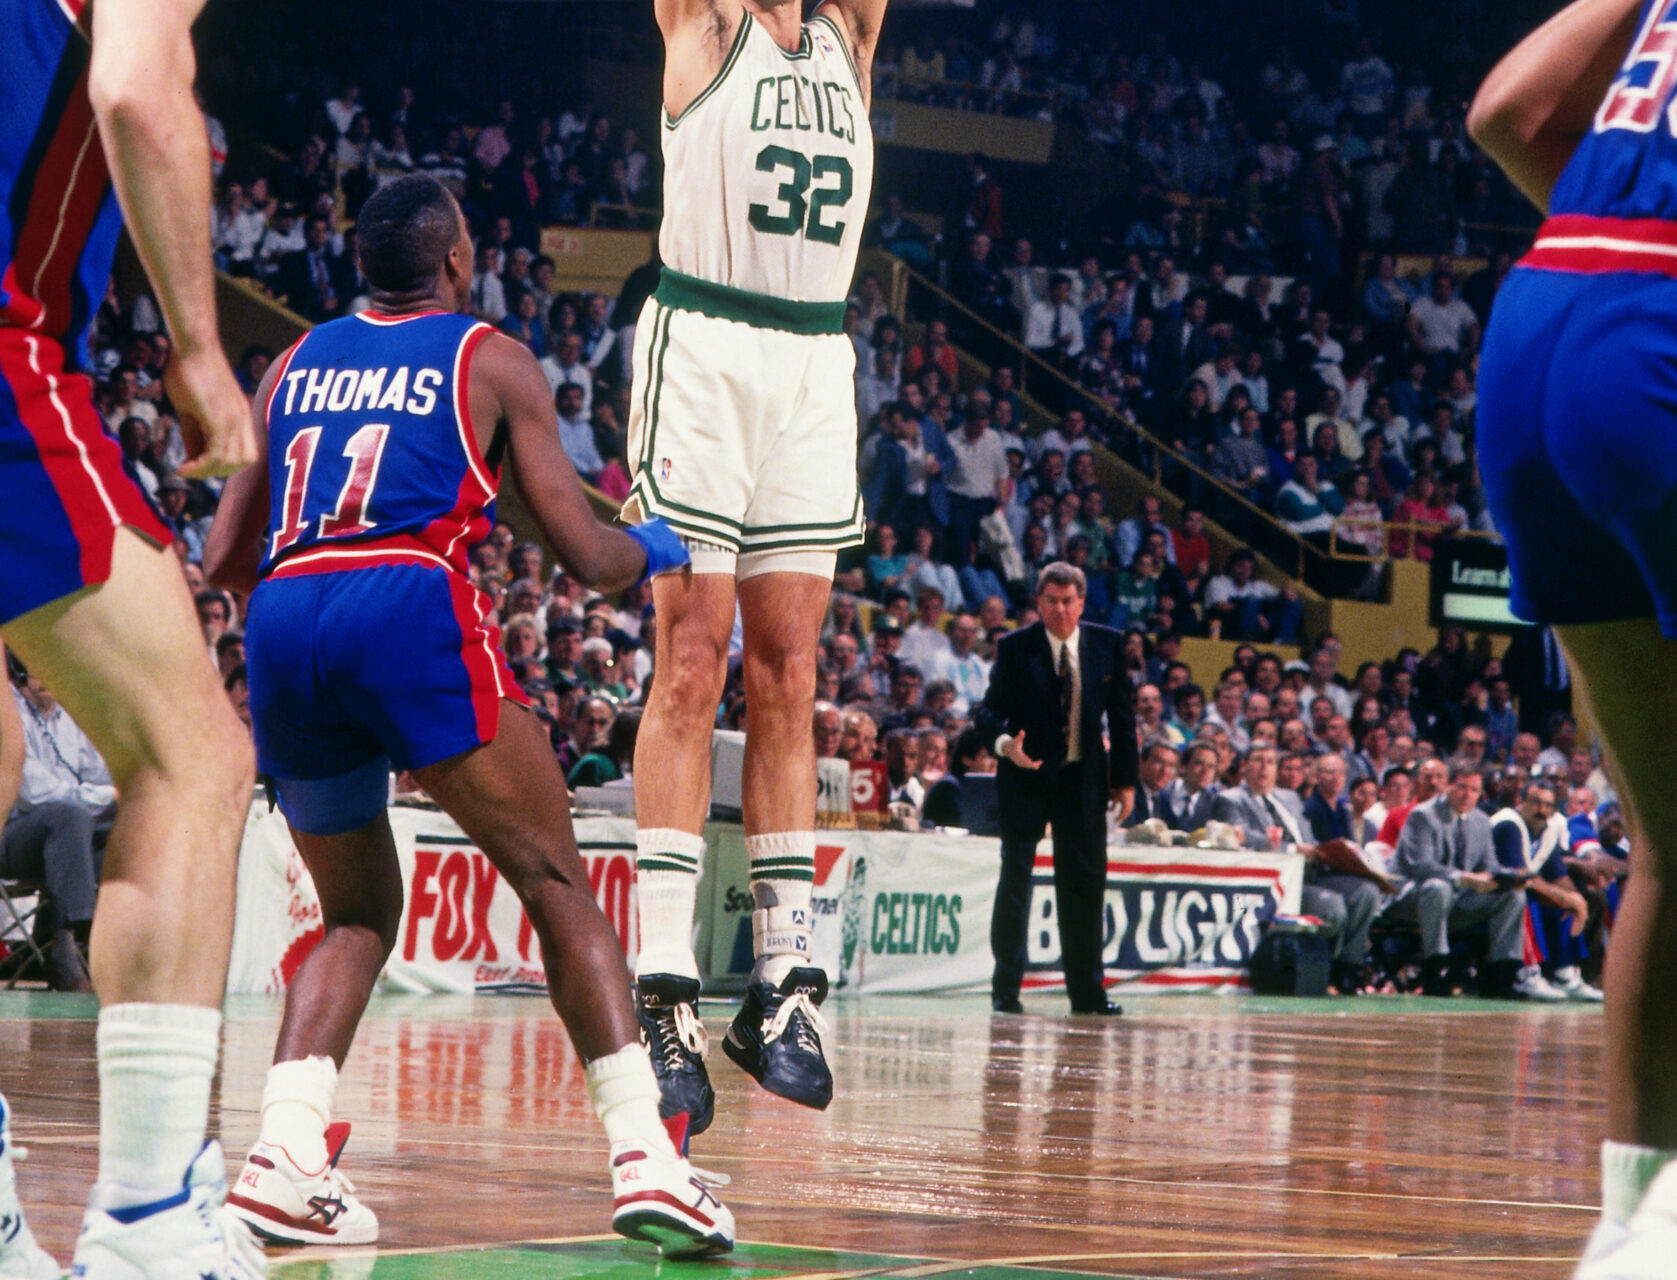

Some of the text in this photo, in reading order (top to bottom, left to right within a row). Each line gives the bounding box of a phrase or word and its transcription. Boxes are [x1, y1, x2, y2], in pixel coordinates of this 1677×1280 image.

[747, 144, 853, 247] 32
[284, 366, 444, 415] THOMAS
[269, 423, 391, 559] 11
[851, 768, 875, 804] 5
[403, 851, 499, 962] FOX
[870, 891, 963, 956] CELTICS
